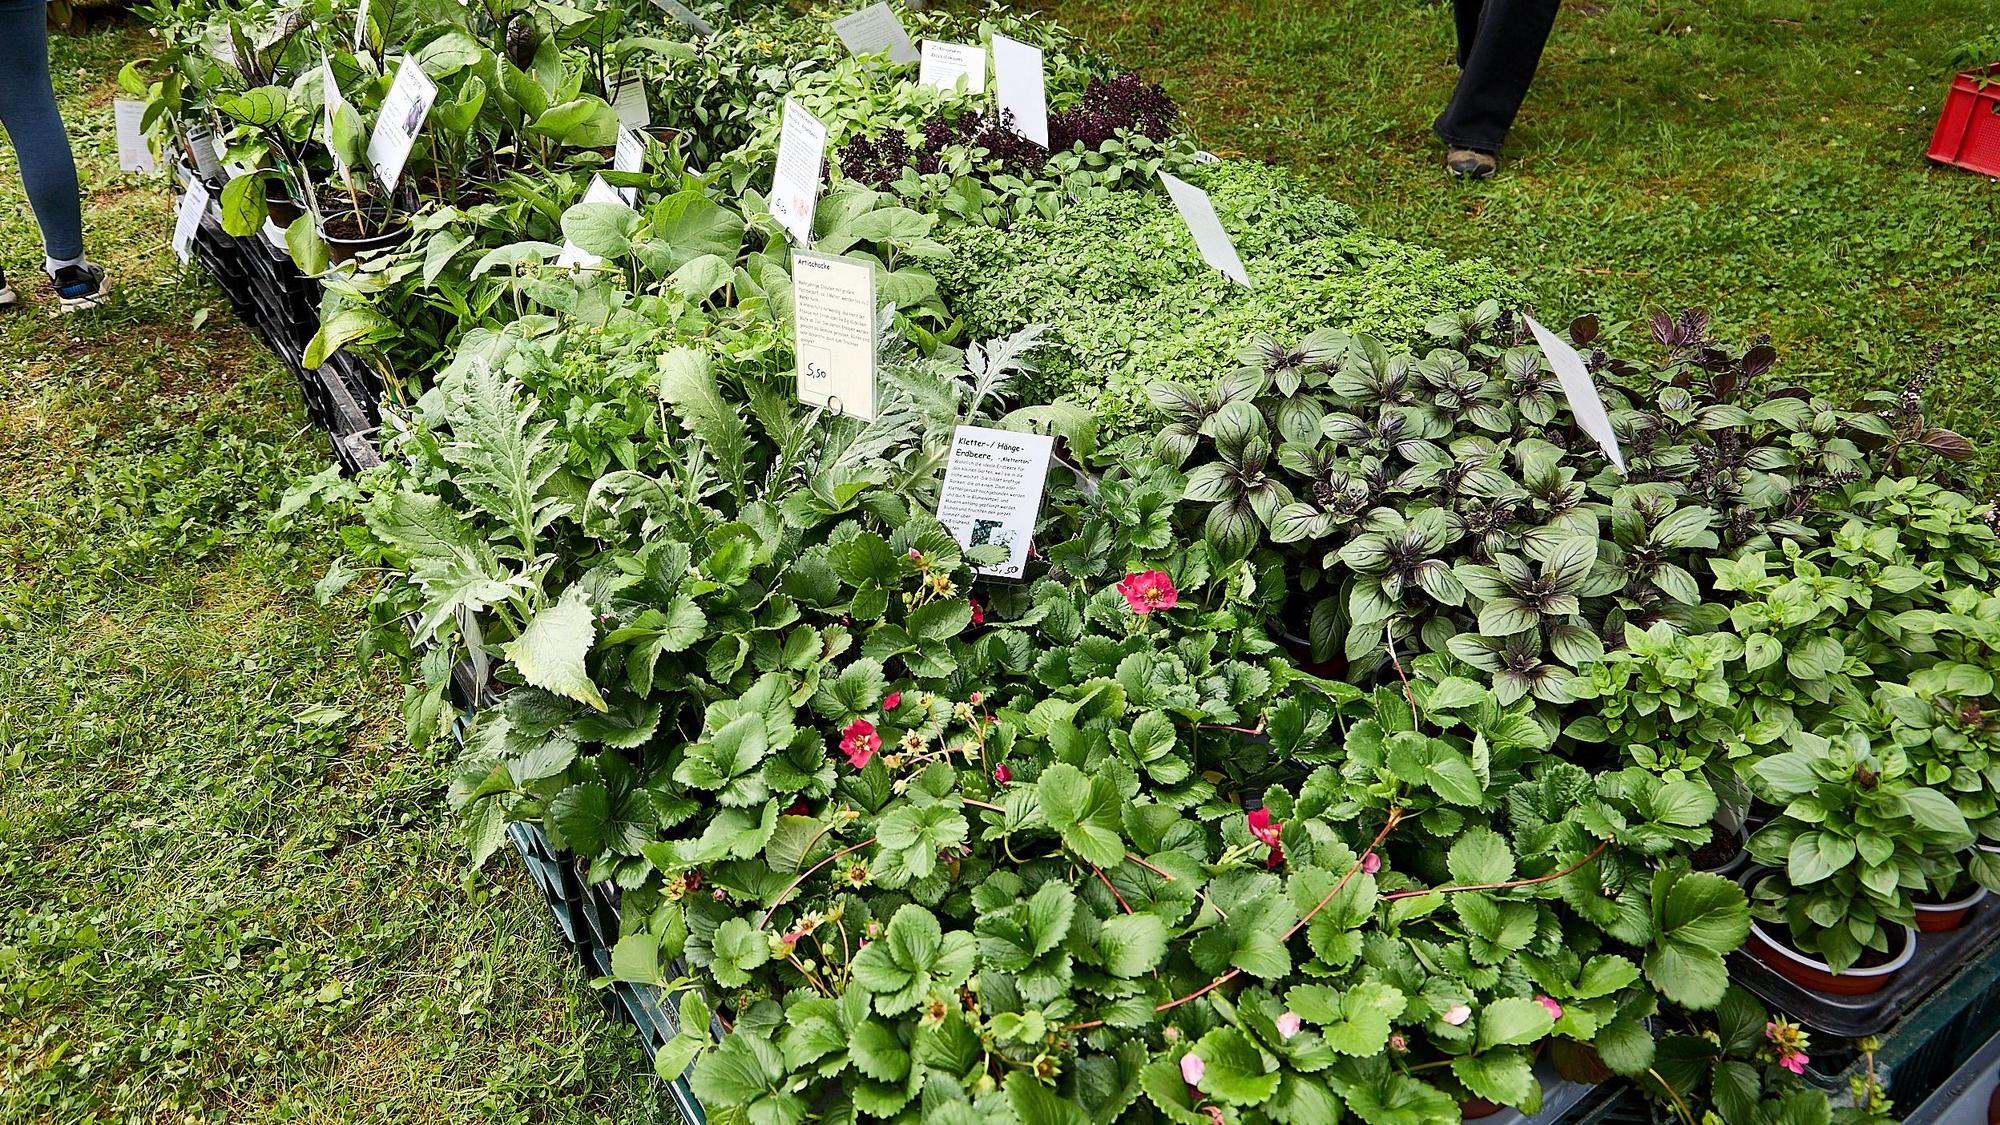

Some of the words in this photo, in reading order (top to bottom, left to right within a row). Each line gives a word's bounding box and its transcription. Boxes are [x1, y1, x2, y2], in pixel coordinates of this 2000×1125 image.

[806, 362, 827, 379] 5,50
[958, 437, 995, 448] Kletter-/
[996, 442, 1024, 454] Hänge-
[955, 449, 994, 460] Erdbeere,
